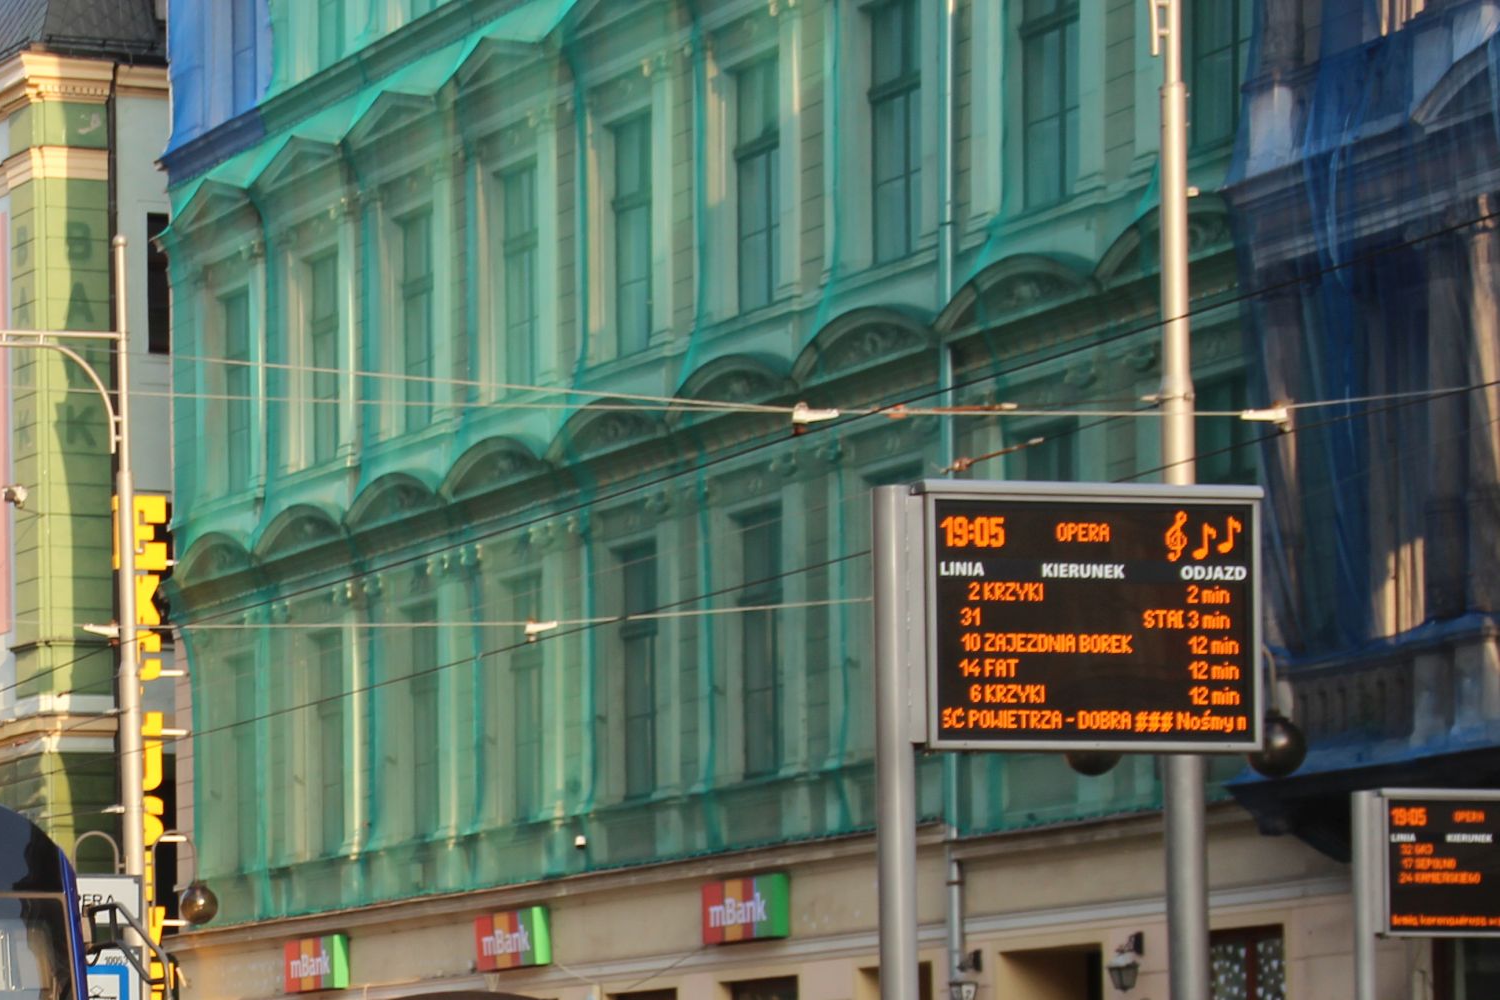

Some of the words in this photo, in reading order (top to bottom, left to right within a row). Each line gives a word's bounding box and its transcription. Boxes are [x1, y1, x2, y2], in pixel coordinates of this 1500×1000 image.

[940, 516, 1005, 547] 19:05
[1056, 522, 1111, 543] OPERA
[939, 561, 985, 577] LINIA
[1041, 563, 1125, 580] KIERUNEK
[1180, 565, 1247, 581] ODJAZD
[968, 582, 981, 601] 2
[983, 582, 1044, 602] KRZYKI
[1186, 585, 1199, 604] 2
[1201, 586, 1231, 604] min
[960, 607, 981, 627] 31
[1187, 611, 1200, 630] 3
[1202, 612, 1231, 630] min
[961, 633, 981, 651] 10
[984, 633, 1076, 653] ZAJEZDNIA
[1079, 634, 1134, 655] BOREK
[1188, 637, 1209, 655] 12
[1211, 637, 1240, 655] min
[959, 659, 981, 677] 14
[984, 659, 1020, 677] FAT
[1189, 661, 1209, 680] 12
[1211, 662, 1240, 680] min
[970, 685, 982, 703] 6
[985, 684, 1046, 703] KRZYKI
[1189, 687, 1210, 706] 12
[1212, 687, 1241, 706] min
[968, 710, 1062, 729] POWIETRZA
[1077, 711, 1132, 730] DOBRA
[1176, 710, 1234, 733] Nośmy
[1391, 807, 1427, 826] 19:05
[1391, 833, 1416, 842] LINIA
[1446, 833, 1493, 843] KIERUNEK
[708, 892, 768, 928] mBank
[482, 924, 530, 957] mBank
[290, 949, 331, 979] mBank
